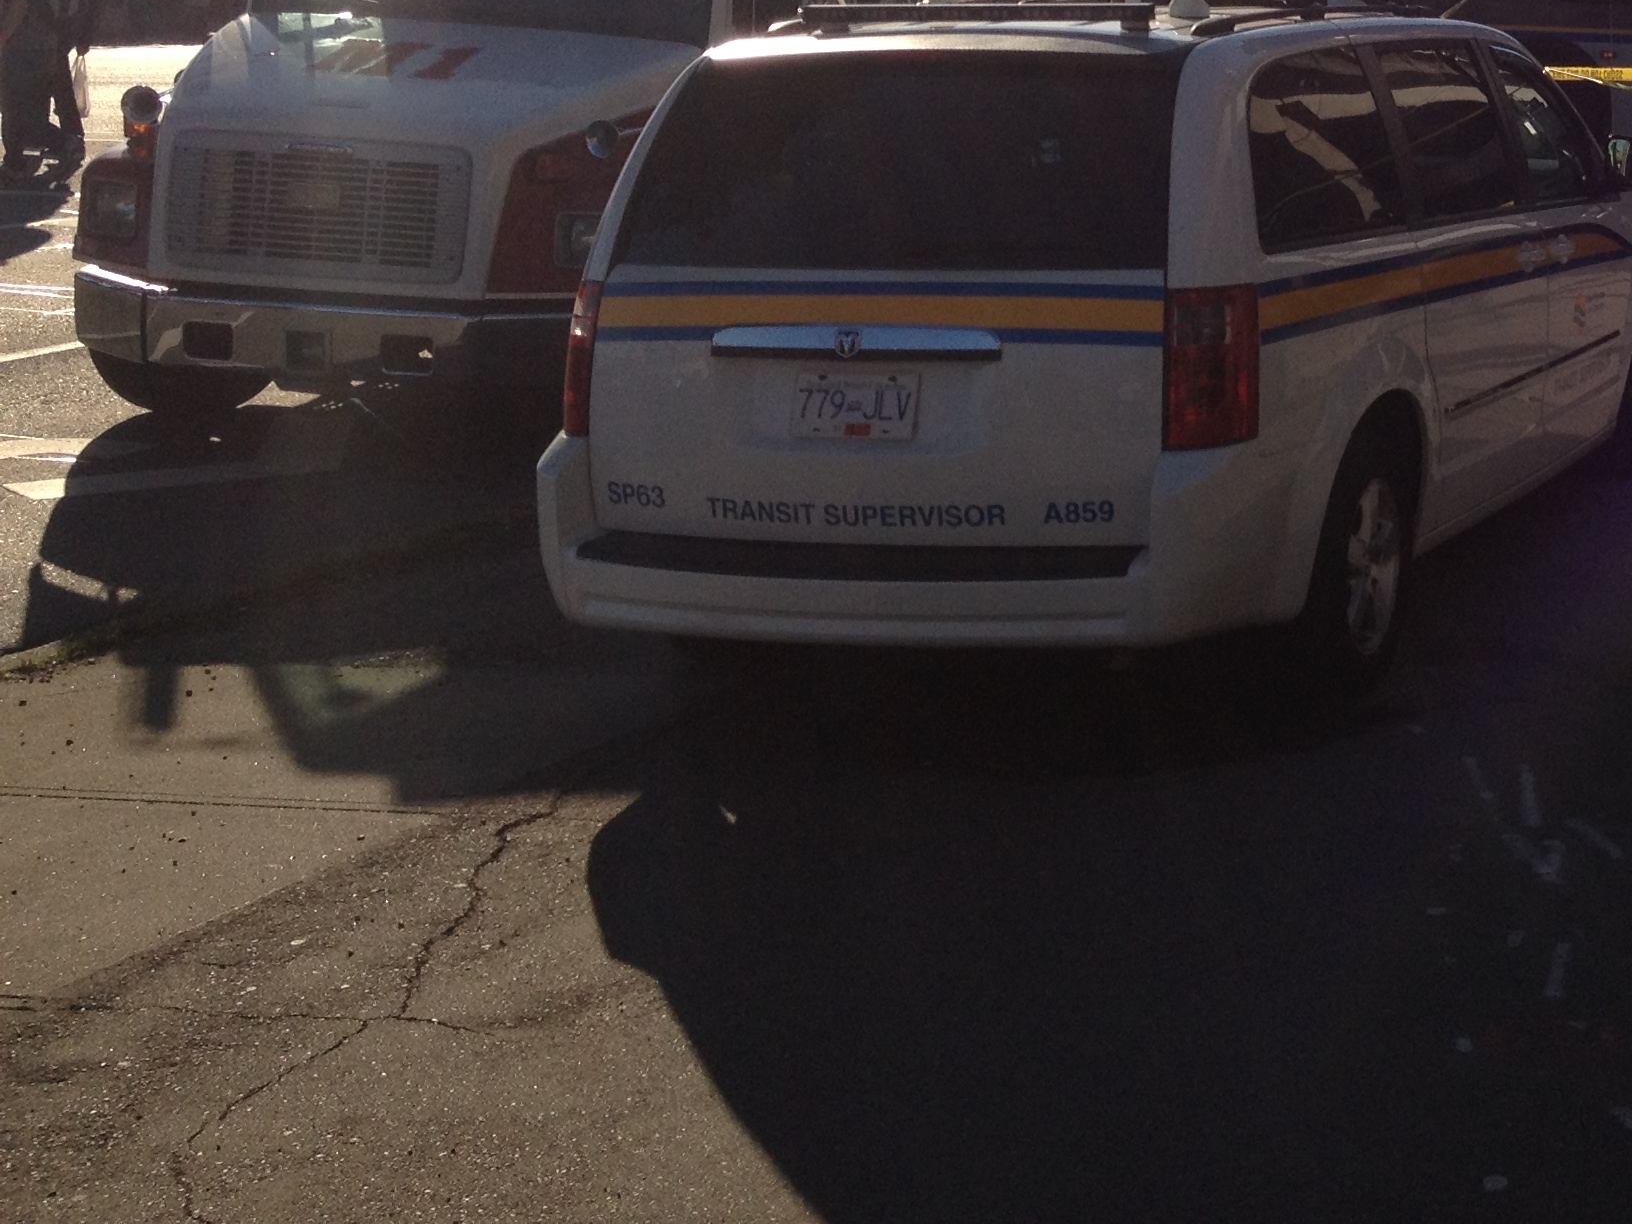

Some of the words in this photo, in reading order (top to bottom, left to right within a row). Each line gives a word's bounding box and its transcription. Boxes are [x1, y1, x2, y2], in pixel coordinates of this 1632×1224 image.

[799, 388, 846, 420] 779
[863, 390, 912, 421] JLV
[607, 481, 666, 508] SP63
[706, 496, 816, 526] TRANSIT
[823, 503, 1006, 528] SUPERVISOR
[1043, 500, 1115, 525] A859
